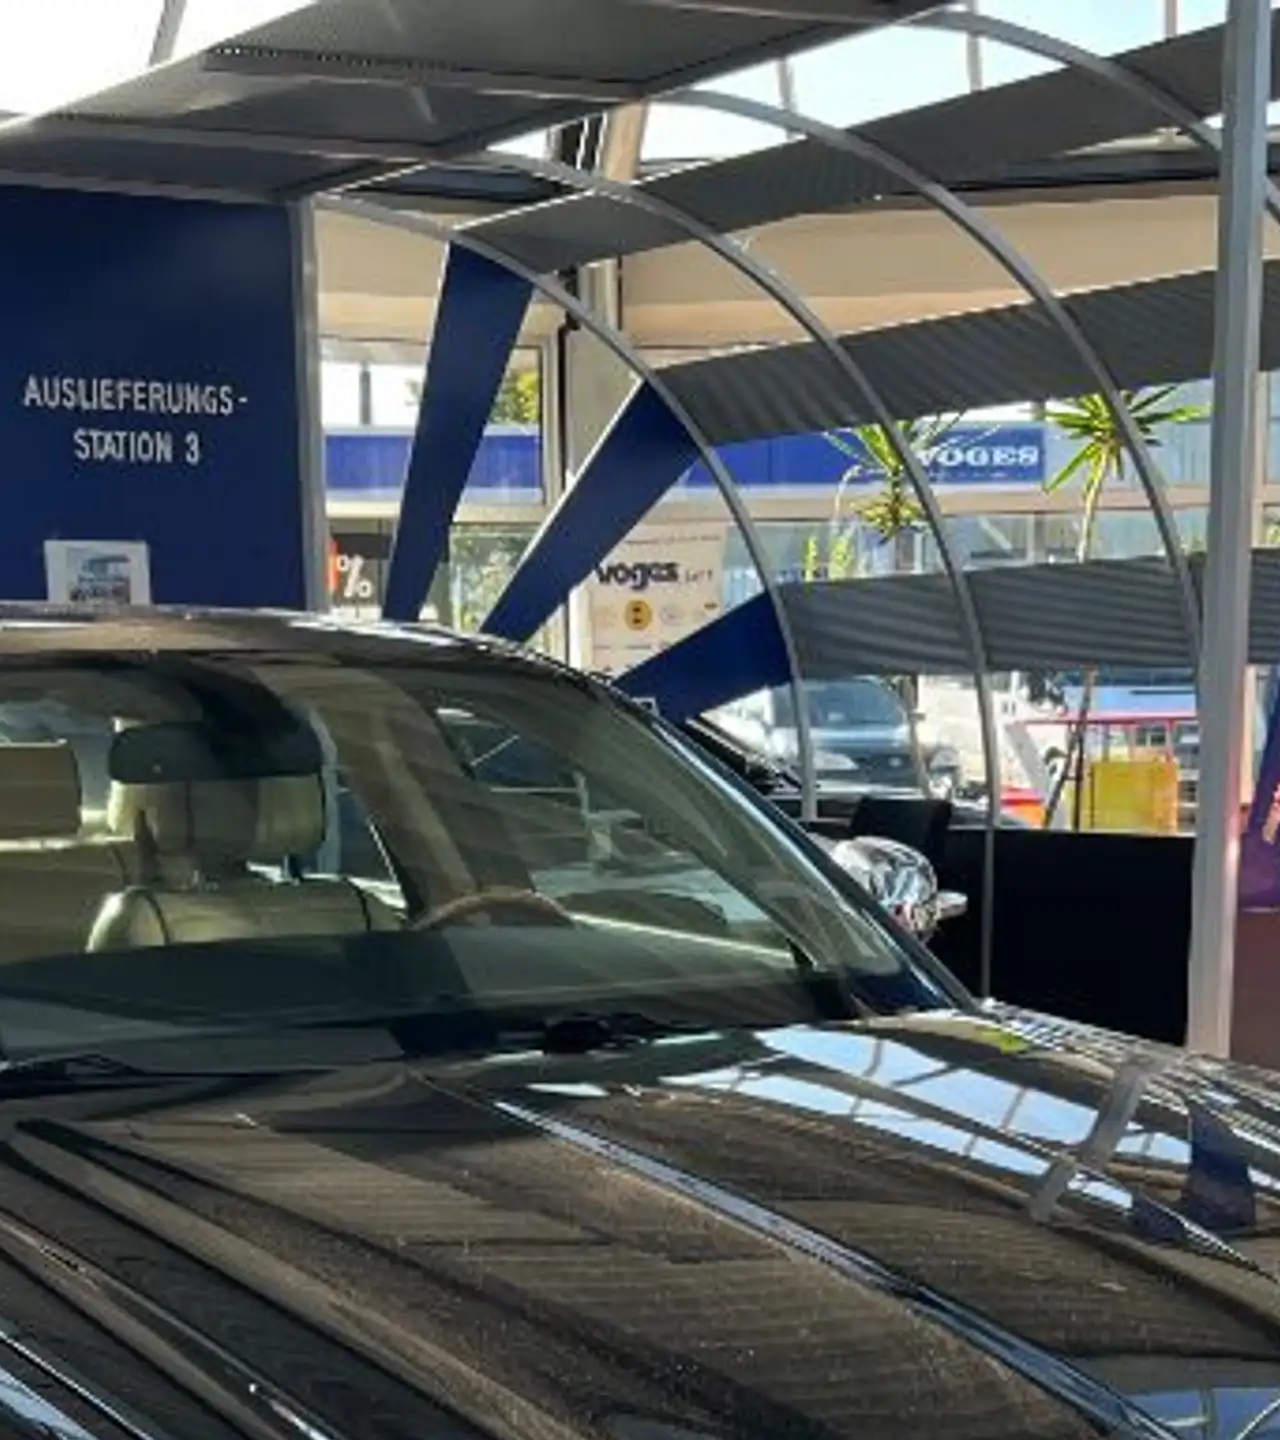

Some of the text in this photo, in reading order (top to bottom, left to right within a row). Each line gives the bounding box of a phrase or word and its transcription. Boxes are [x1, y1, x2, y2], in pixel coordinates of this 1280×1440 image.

[23, 374, 248, 416] AUSLIEFERUNGS-
[73, 428, 201, 465] STATION 3
